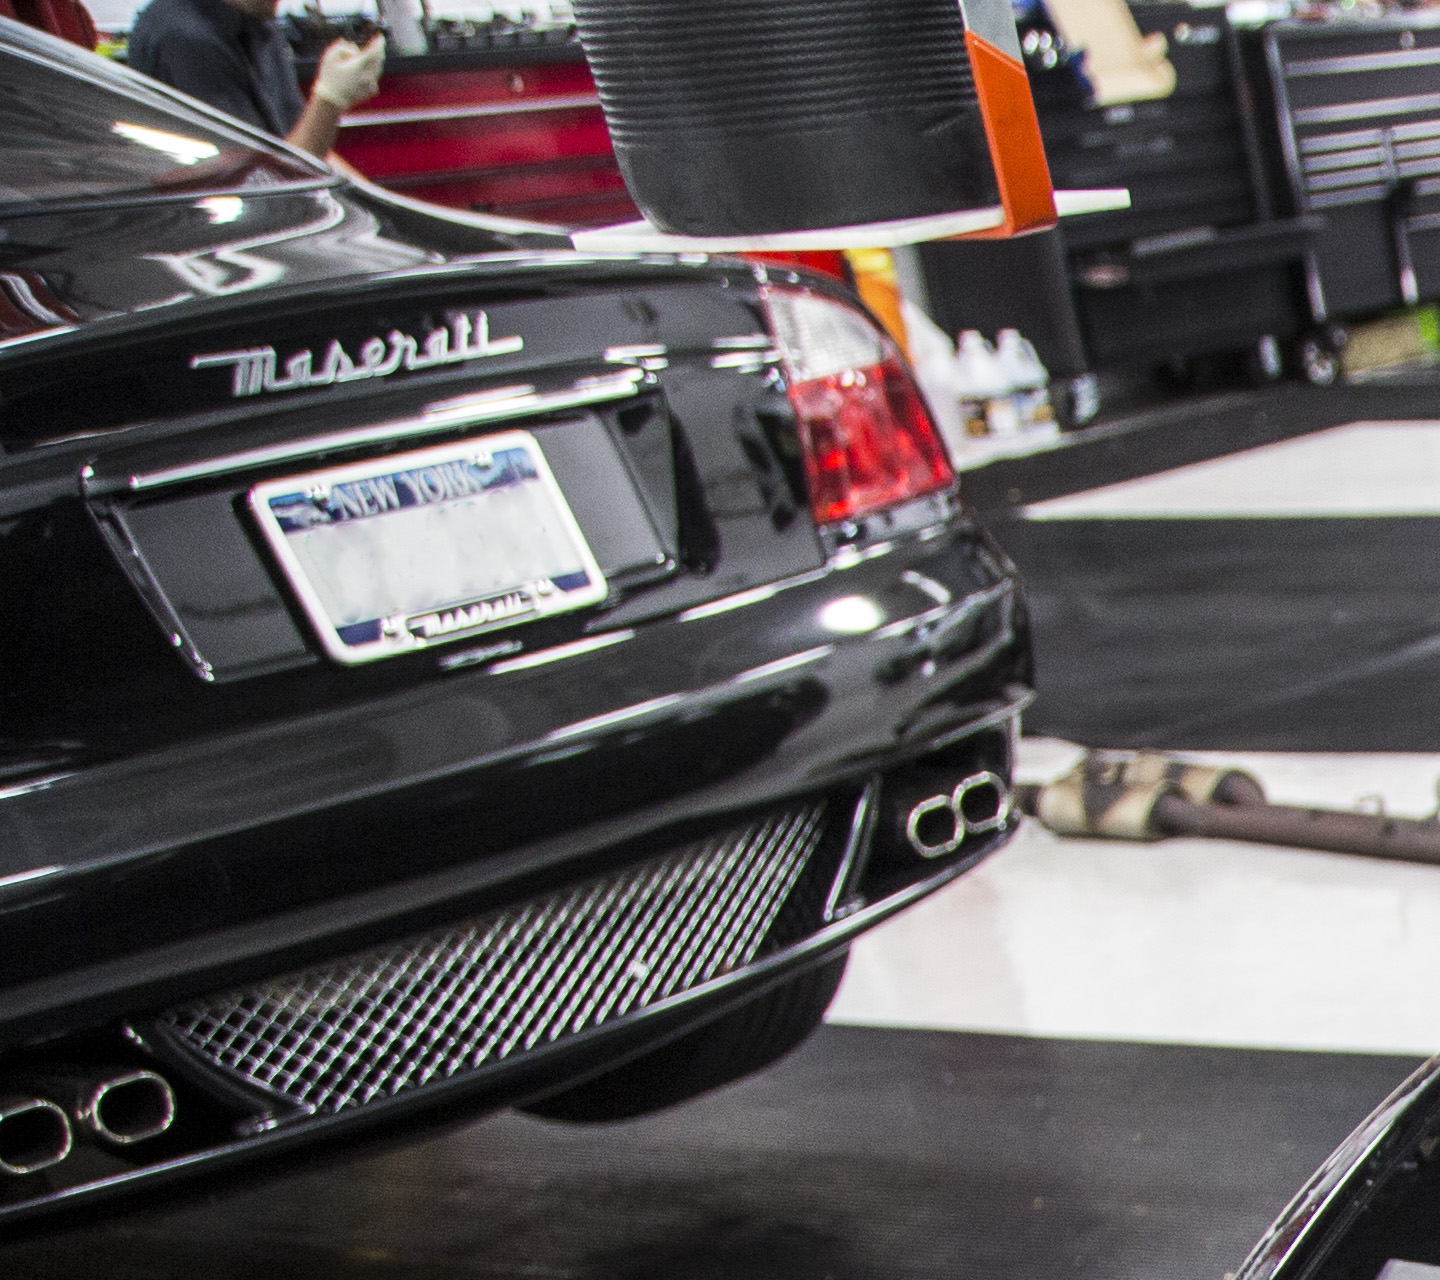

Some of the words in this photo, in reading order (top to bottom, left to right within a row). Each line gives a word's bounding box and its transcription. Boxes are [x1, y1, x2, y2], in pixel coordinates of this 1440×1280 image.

[188, 309, 524, 398] Maserati
[329, 471, 402, 521] NEW
[399, 459, 487, 504] YORK
